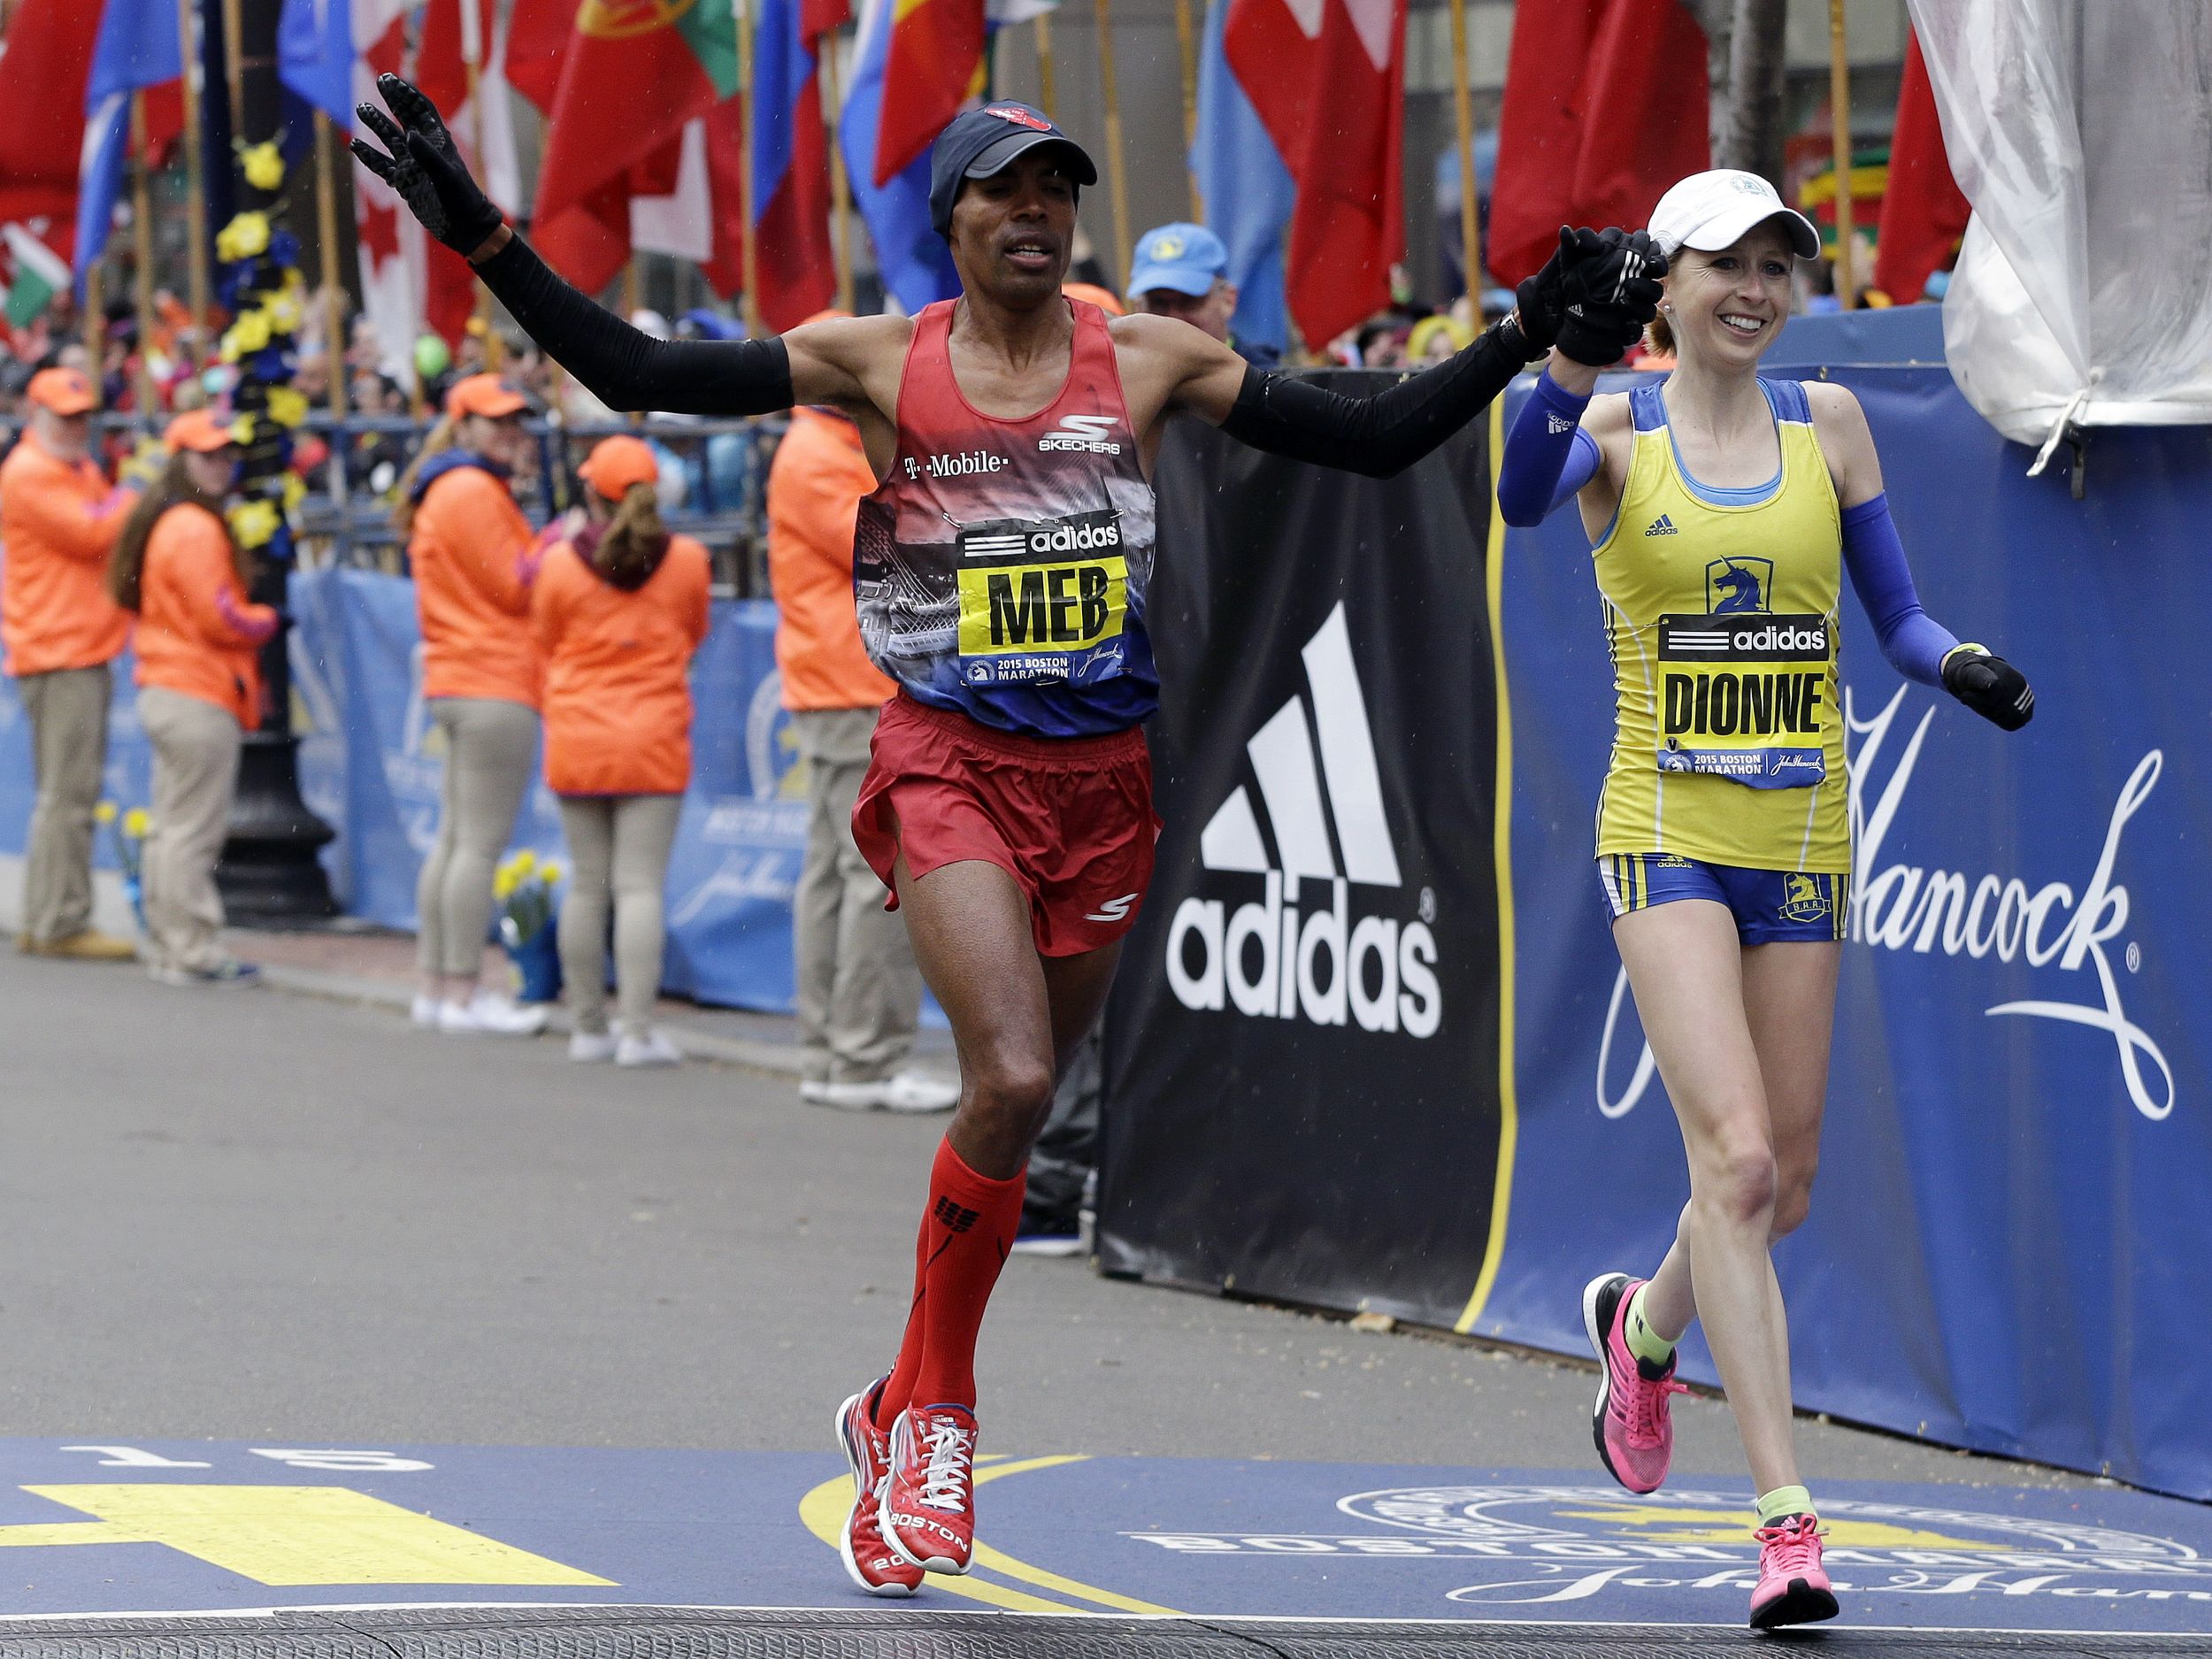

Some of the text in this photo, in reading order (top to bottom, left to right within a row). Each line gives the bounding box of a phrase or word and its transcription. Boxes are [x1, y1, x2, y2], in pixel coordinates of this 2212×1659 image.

[1039, 439, 1121, 455] SKECHERS
[1030, 523, 1118, 553] adidas
[1645, 526, 1678, 537] adidas
[987, 566, 1110, 646] MEB
[1733, 626, 1825, 650] adidas
[998, 657, 1069, 670] 2015 BOSTON
[1664, 672, 1825, 734] DIONNE
[1694, 755, 1717, 764] 2015
[1721, 755, 1762, 764] BOSTON
[1694, 764, 1763, 775] MARATHON
[1657, 860, 1693, 869] adidas
[1793, 900, 1822, 911] B.A.A.
[1165, 869, 1443, 1039] adidas
[891, 1513, 969, 1553] BOSTON
[1129, 1534, 1745, 1561] BOSTON
